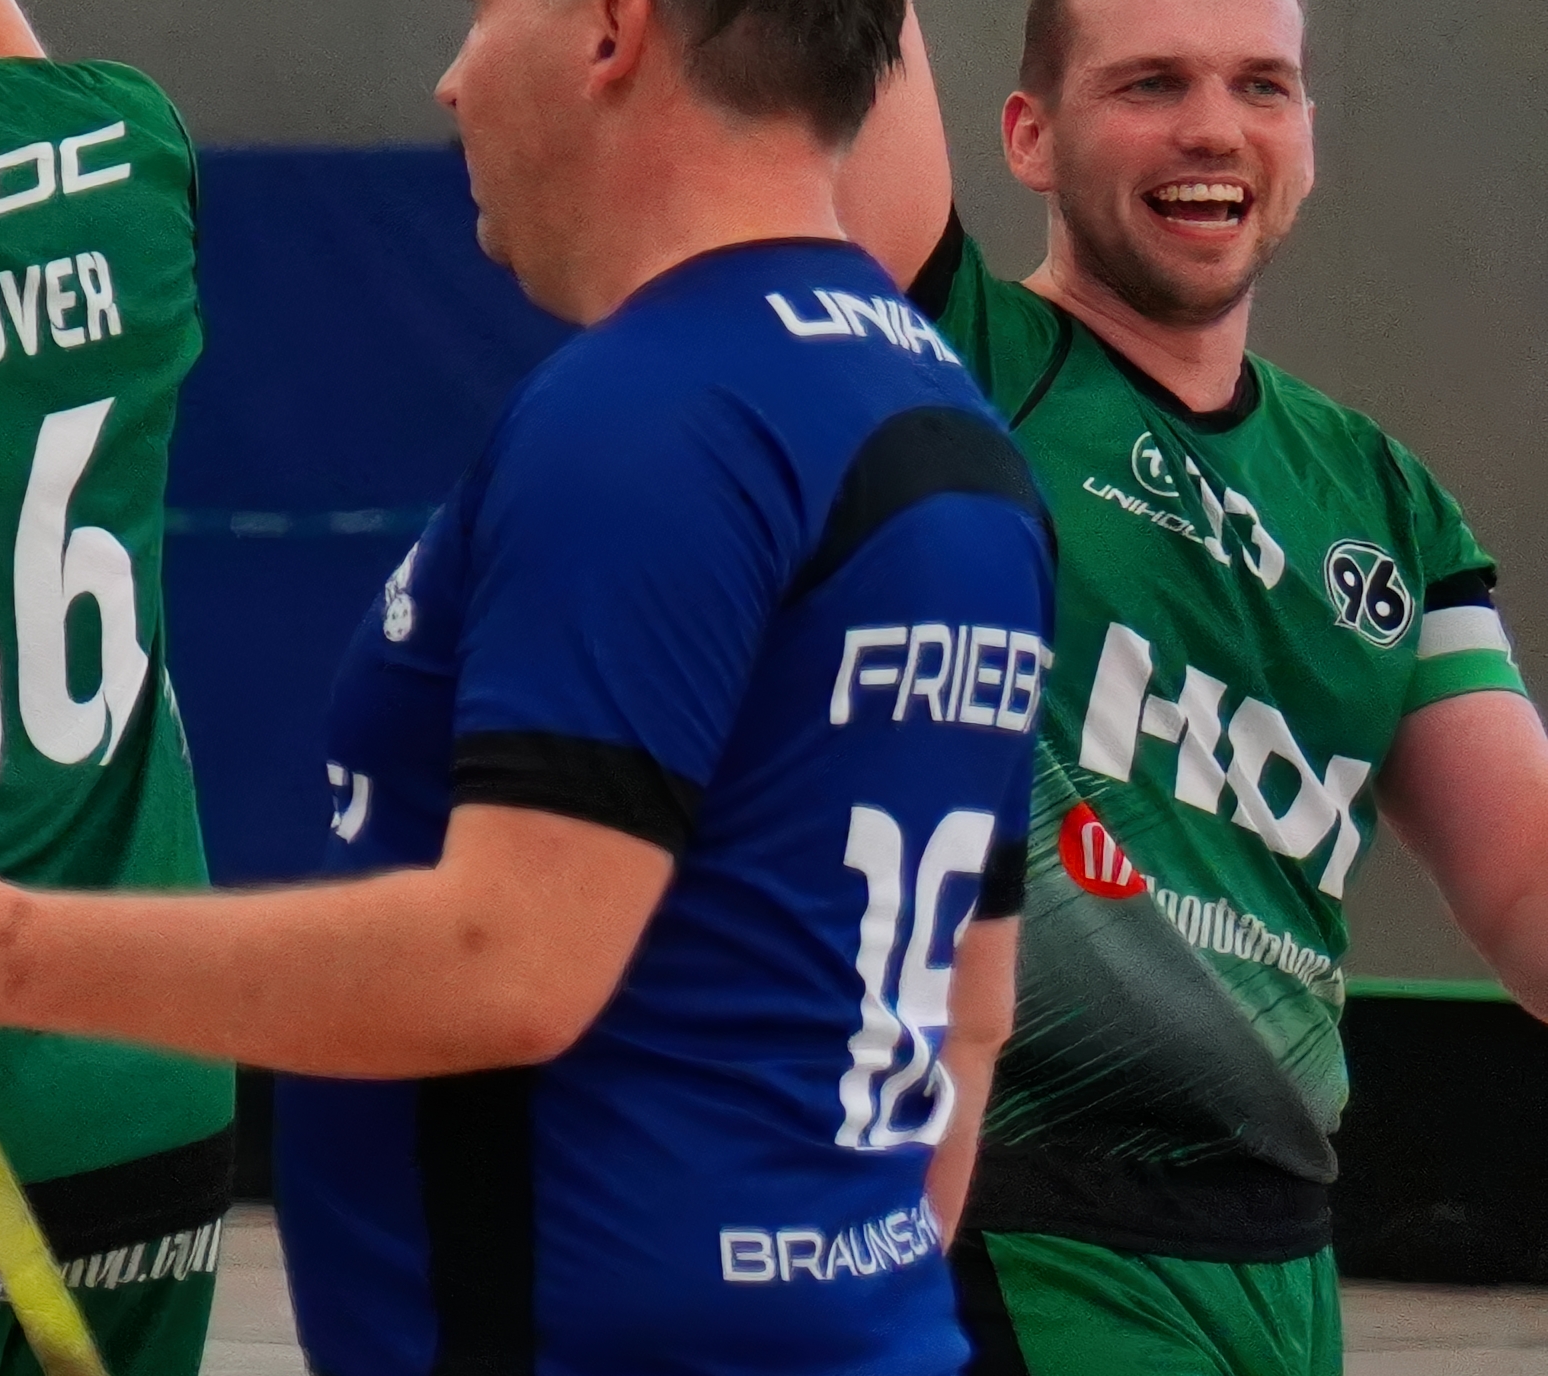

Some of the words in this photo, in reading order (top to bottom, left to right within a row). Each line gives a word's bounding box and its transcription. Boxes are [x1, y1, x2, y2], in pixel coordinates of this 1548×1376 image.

[764, 288, 961, 366] UNIH
[1330, 545, 1411, 640] 96
[830, 625, 1053, 734] FRIEB
[835, 806, 995, 1151] 16
